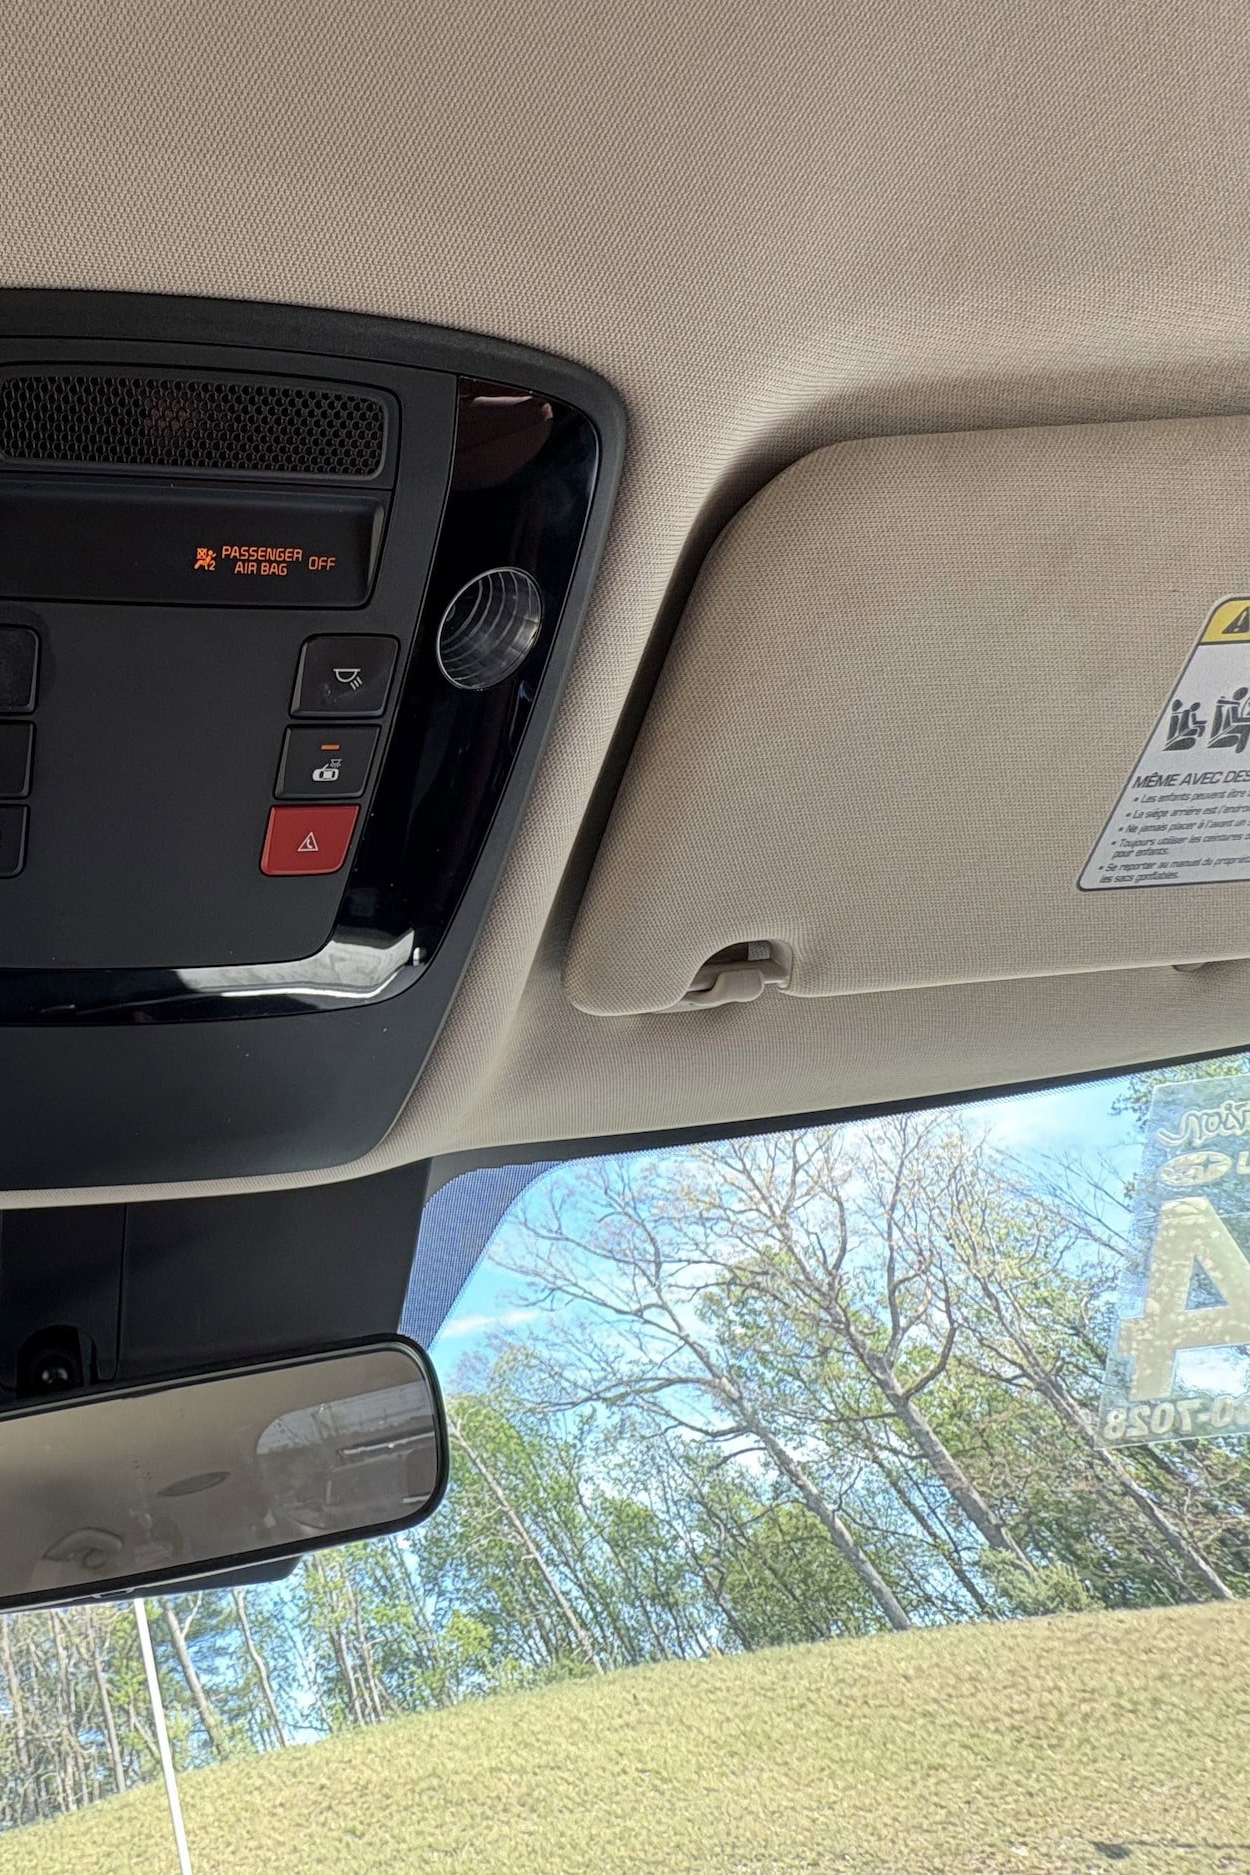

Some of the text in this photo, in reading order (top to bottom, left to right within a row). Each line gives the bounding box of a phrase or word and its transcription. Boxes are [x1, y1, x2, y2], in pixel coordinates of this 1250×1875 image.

[221, 545, 303, 562] PASSENGER
[234, 561, 288, 576] AIR BAG
[308, 556, 336, 571] OFF
[1132, 771, 1181, 789] MÊME
[1179, 771, 1223, 786] AVEC
